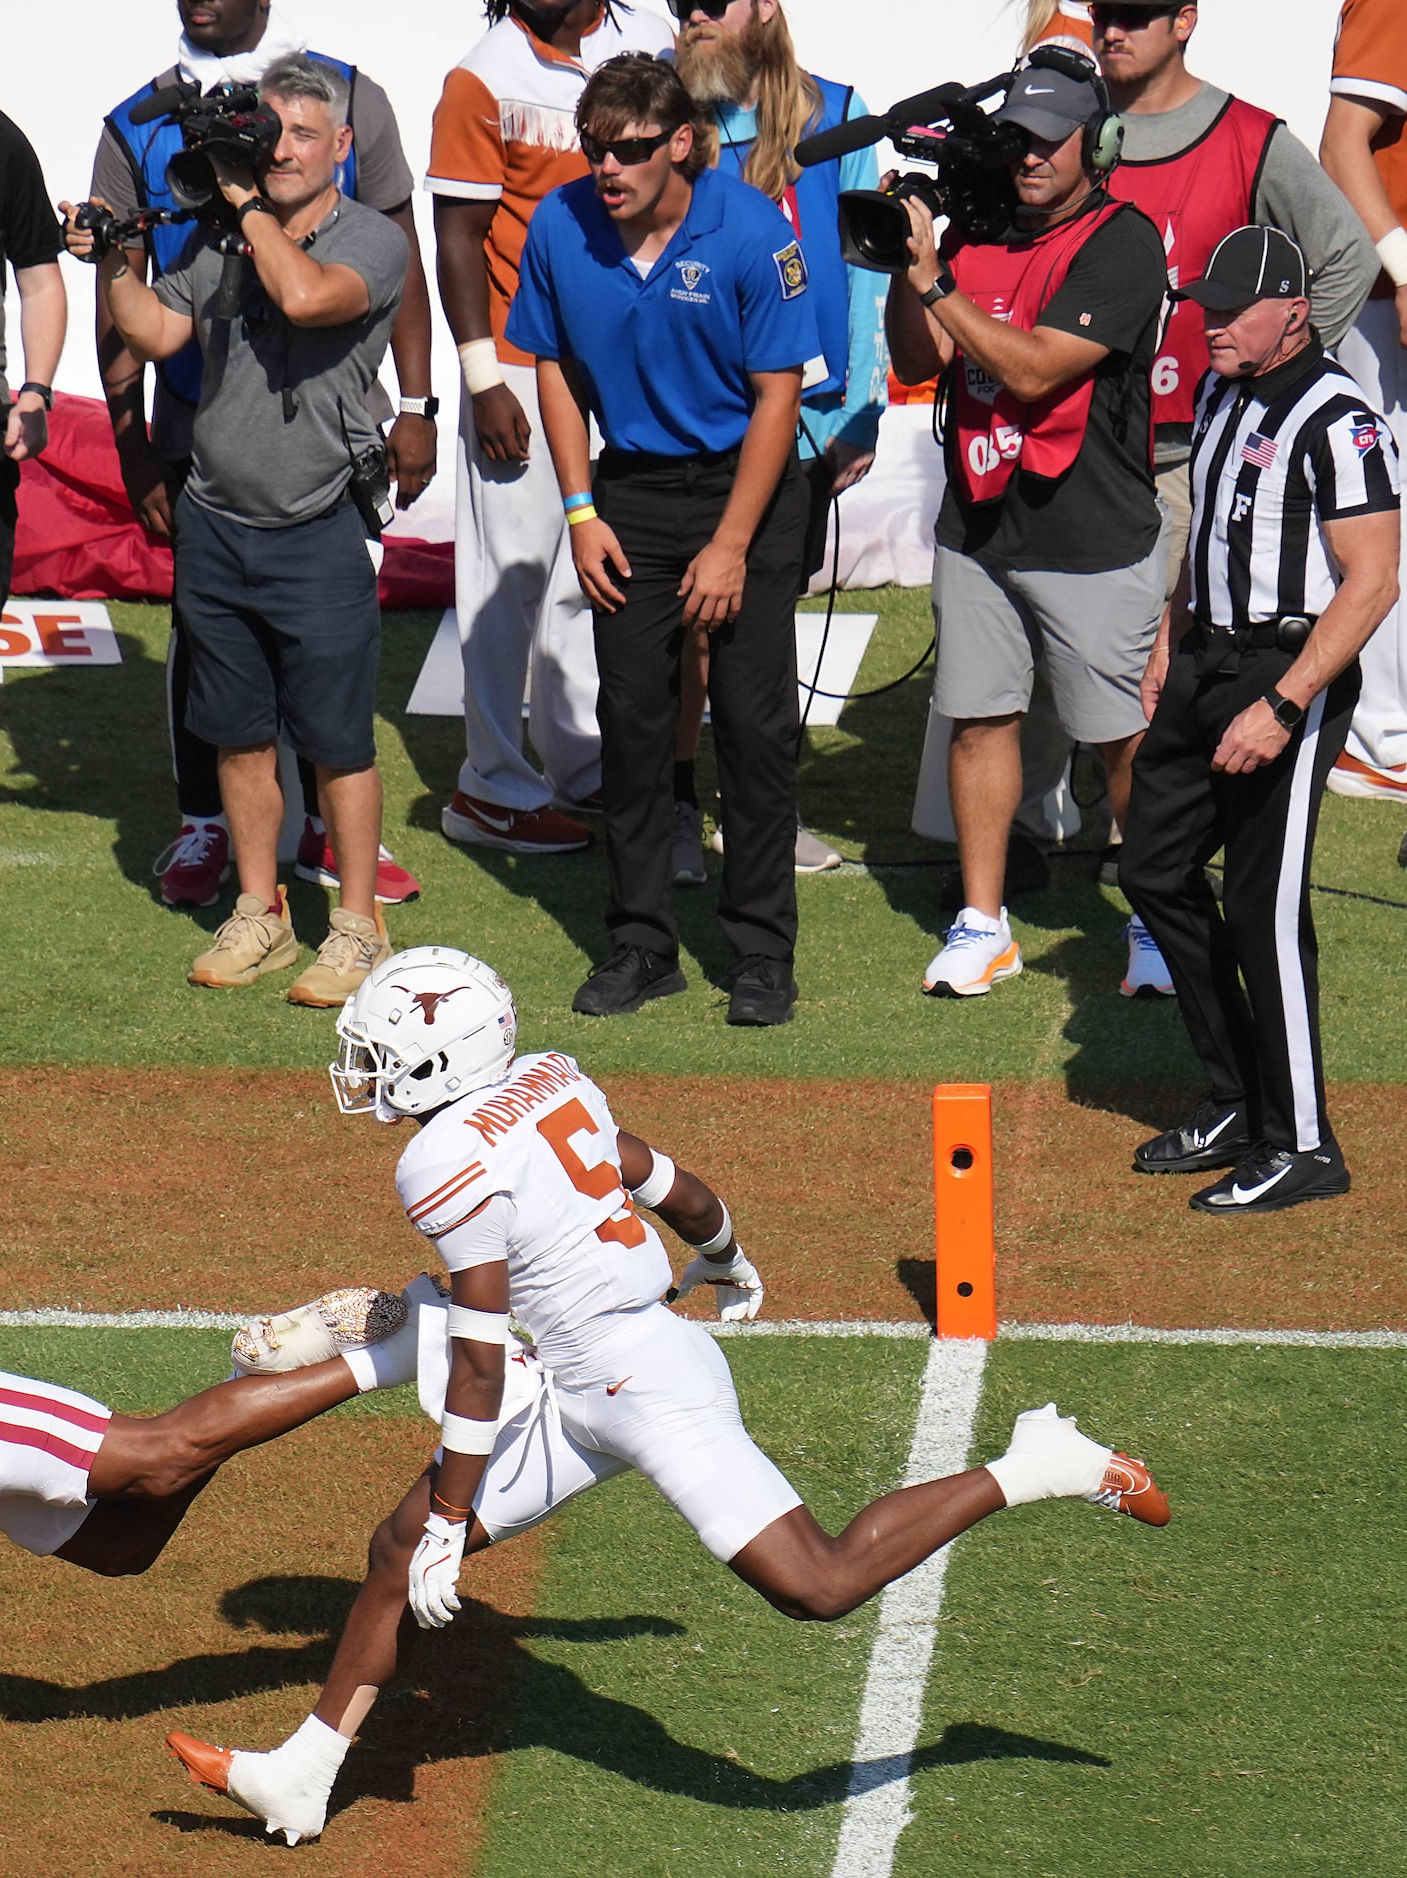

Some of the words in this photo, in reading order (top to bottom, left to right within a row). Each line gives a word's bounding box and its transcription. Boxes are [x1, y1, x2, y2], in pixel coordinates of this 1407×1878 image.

[1279, 279, 1290, 293] S
[1232, 493, 1252, 522] F
[463, 1053, 582, 1148] MUHAMMAD
[535, 1096, 647, 1250] 5
